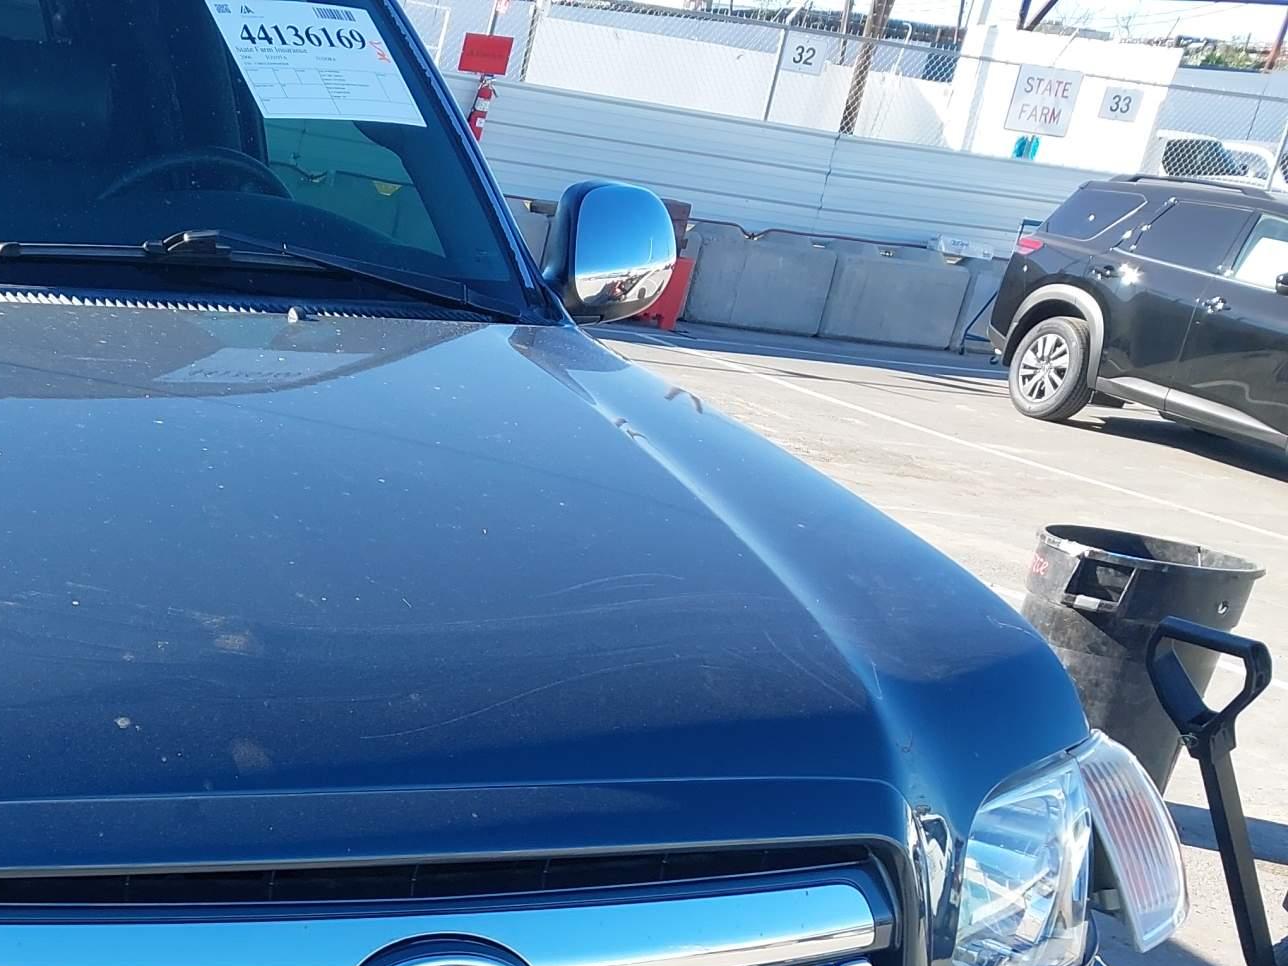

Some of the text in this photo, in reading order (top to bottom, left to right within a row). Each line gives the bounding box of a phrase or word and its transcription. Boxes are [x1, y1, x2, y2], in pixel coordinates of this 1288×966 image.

[240, 24, 366, 49] 44136169
[793, 45, 816, 66] 32
[1023, 76, 1072, 99] STATE
[1018, 103, 1062, 125] FARM
[1109, 94, 1132, 114] 33
